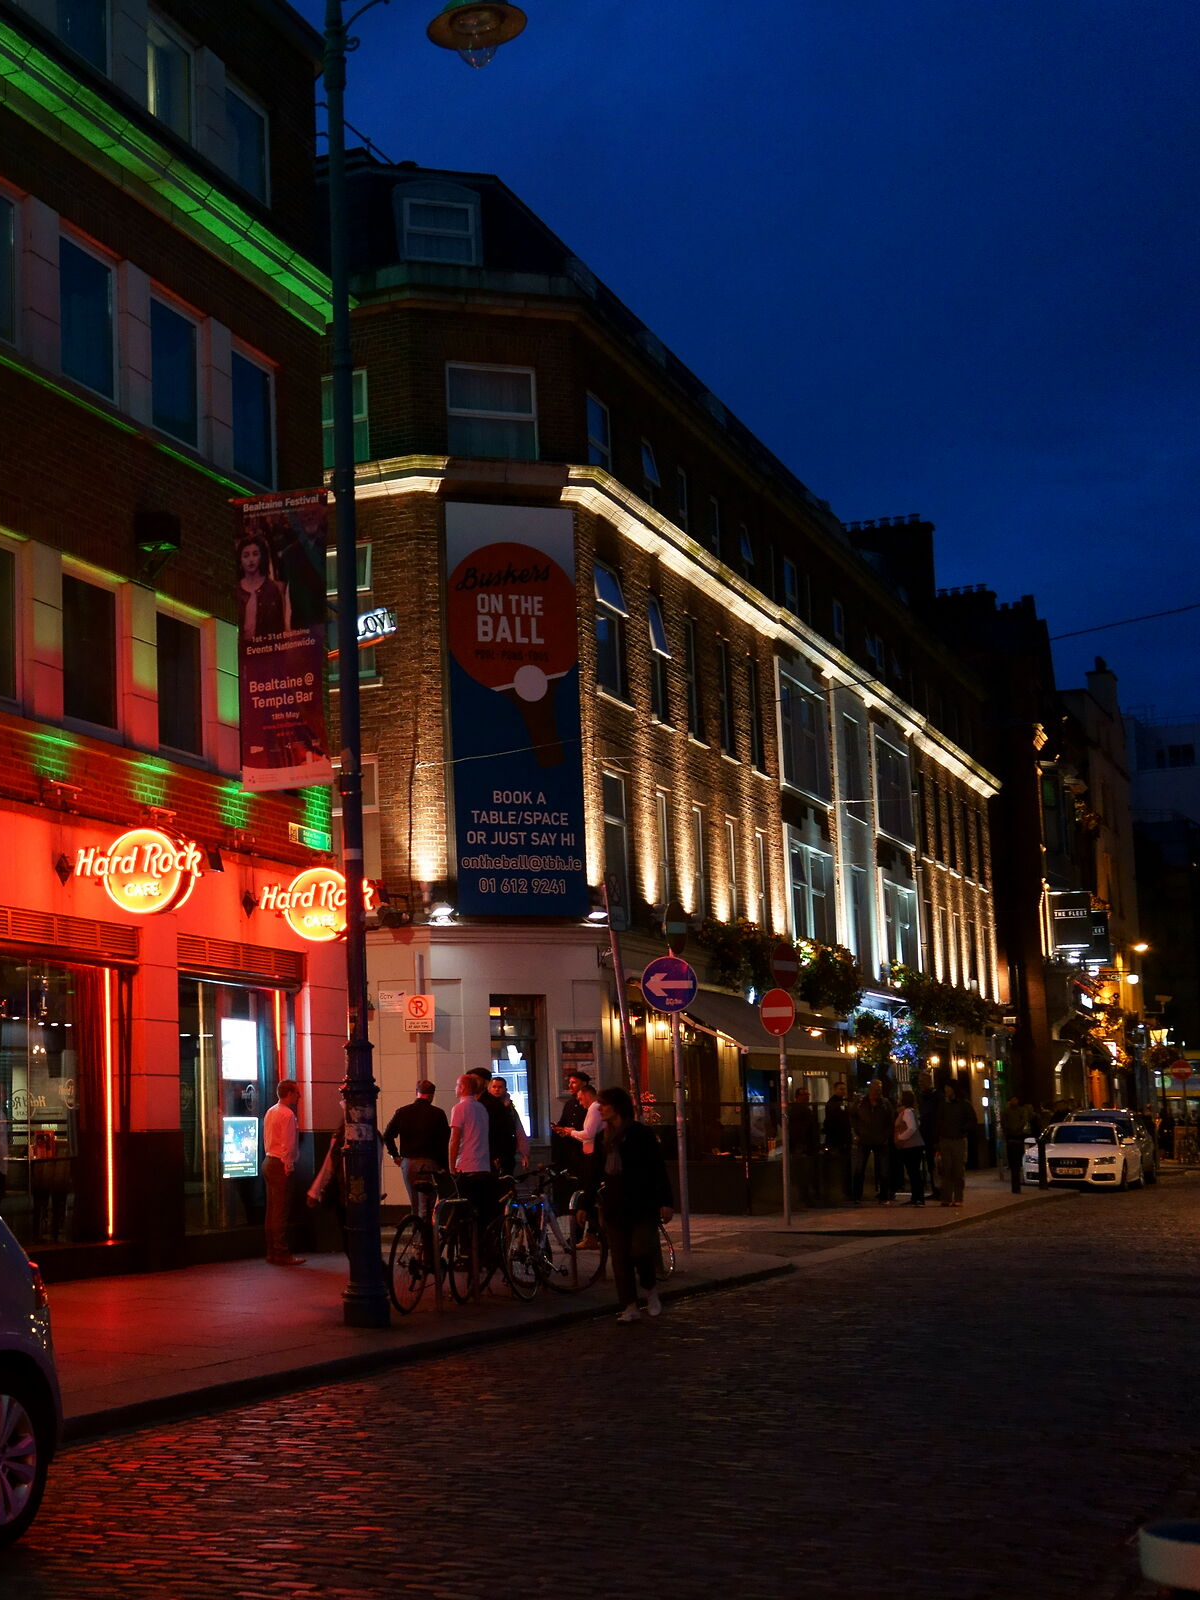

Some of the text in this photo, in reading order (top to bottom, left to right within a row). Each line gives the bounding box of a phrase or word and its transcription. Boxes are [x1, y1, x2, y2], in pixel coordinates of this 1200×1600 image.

[243, 500, 283, 513] Bealtaine
[285, 494, 319, 507] Festival
[456, 562, 551, 591] Buskers
[476, 593, 544, 616] ON THE
[477, 614, 544, 644] BALL
[246, 637, 316, 656] Events Nationwide
[249, 672, 315, 693] Bealtaine @
[251, 691, 314, 709] Temple Bar
[286, 711, 300, 719] May
[492, 790, 547, 805] BOOK A
[471, 810, 569, 826] TABLE/SPACE
[466, 830, 575, 847] OR JUST SAY HI
[76, 841, 203, 879] Hard Rock
[461, 853, 582, 872] ontheball@tbh.ie
[123, 881, 161, 897] CAFE
[478, 877, 567, 894] 01 612 9241
[260, 879, 375, 912] Hard Rok
[303, 913, 336, 928] CAFE
[1068, 909, 1087, 917] FLEET
